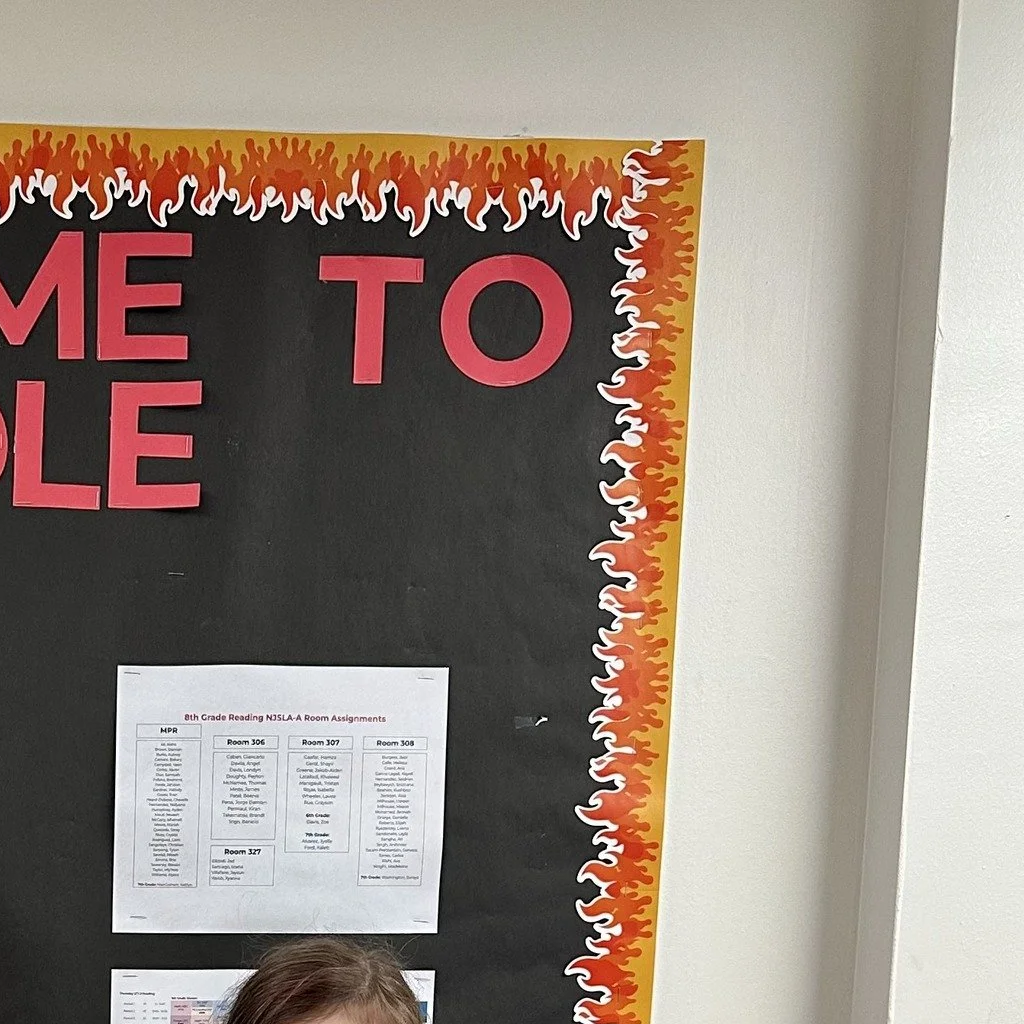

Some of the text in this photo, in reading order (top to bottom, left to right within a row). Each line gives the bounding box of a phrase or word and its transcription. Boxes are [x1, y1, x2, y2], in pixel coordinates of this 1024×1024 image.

[319, 254, 573, 387] TO
[184, 714, 386, 724] 8th Grade Reading NJSLA-A Room Assignments
